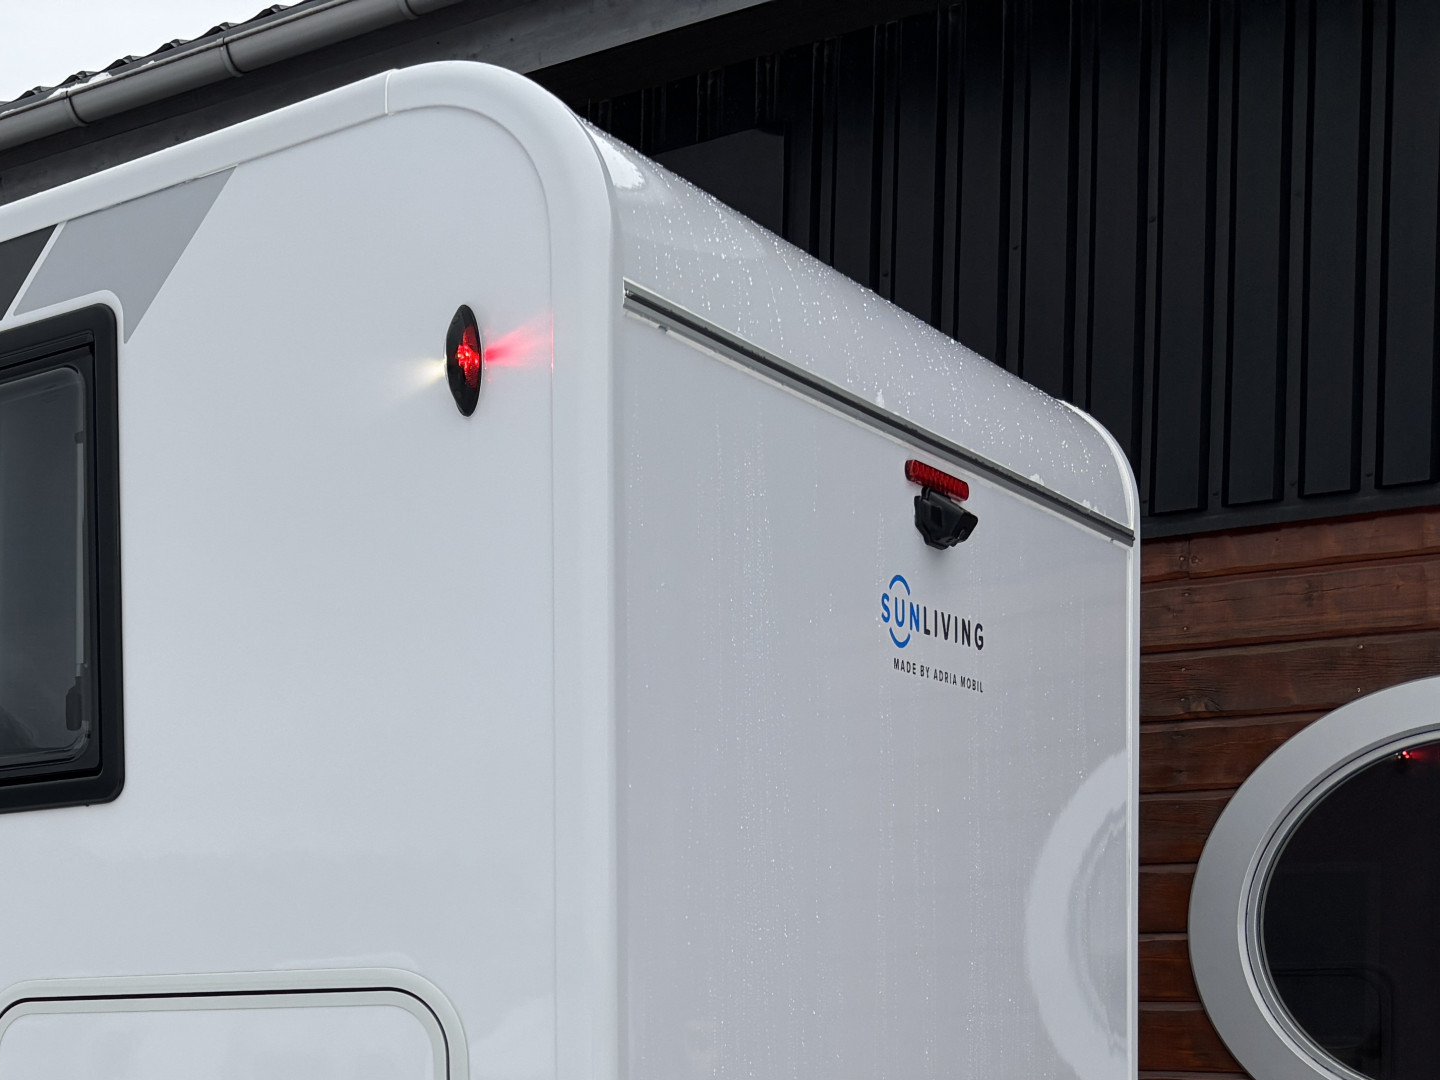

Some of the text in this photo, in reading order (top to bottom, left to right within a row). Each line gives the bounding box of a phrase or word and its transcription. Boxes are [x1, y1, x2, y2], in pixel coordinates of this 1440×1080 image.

[881, 592, 984, 651] SUNLIVING
[893, 657, 984, 693] MADE BY ADRIA MOBIL
